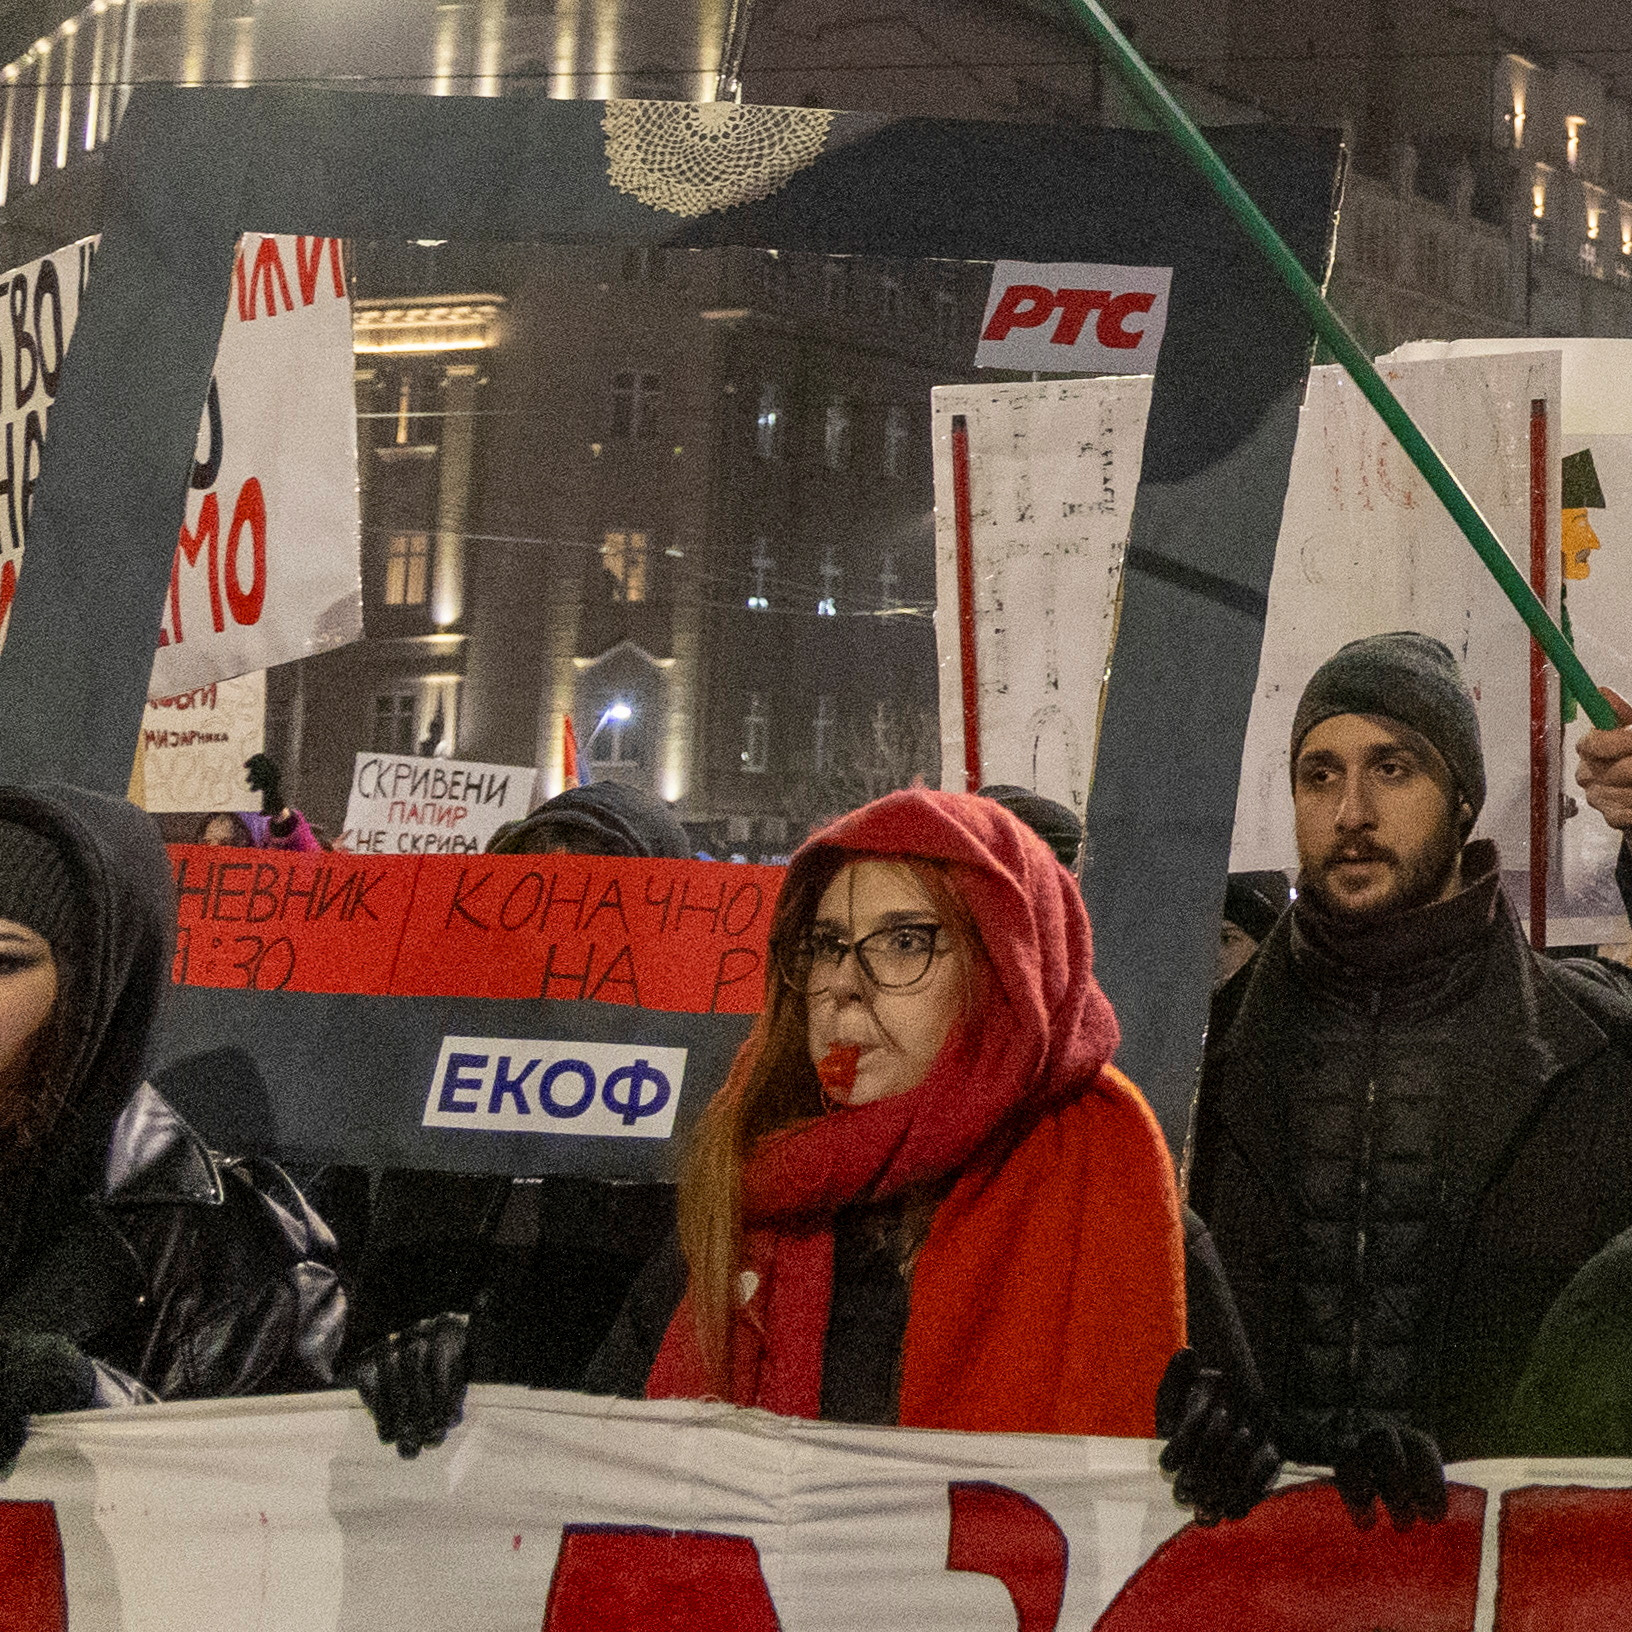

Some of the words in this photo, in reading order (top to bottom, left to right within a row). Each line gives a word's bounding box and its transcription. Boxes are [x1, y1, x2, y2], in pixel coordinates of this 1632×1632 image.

[358, 758, 511, 808] СКРИВЕНИ
[387, 800, 469, 829] ПАПИР
[174, 858, 390, 925] НЕВНИК
[445, 869, 764, 939] КОНАЧНО
[173, 926, 296, 992] 1:30
[539, 945, 641, 1011] НА
[436, 1051, 673, 1127] ЕКОФ
